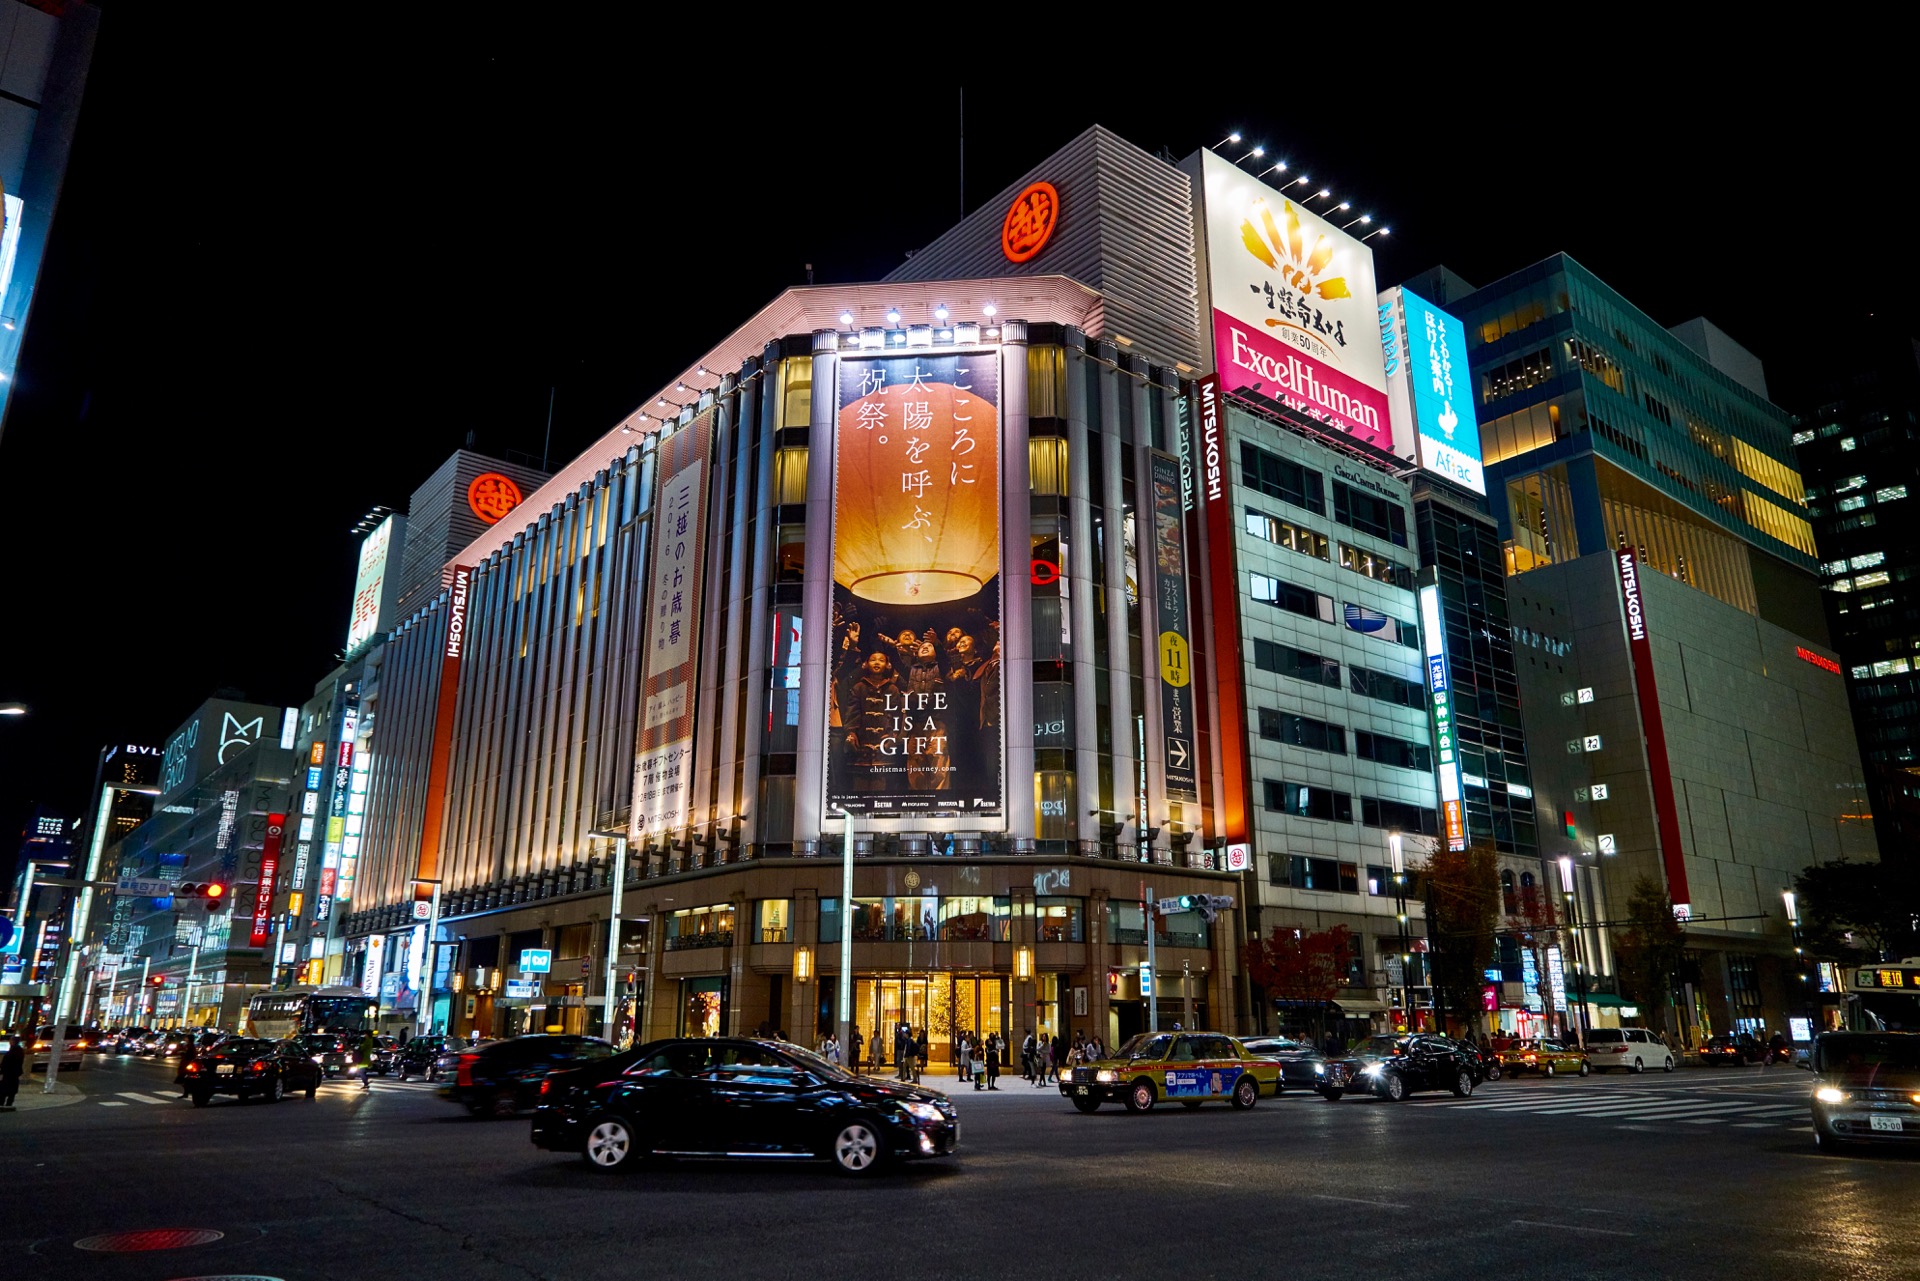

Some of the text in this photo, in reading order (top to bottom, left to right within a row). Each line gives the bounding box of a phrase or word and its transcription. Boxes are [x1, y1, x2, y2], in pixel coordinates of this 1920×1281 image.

[1377, 301, 1399, 378] アフラック
[1424, 310, 1445, 396] ほけん案内
[856, 368, 889, 445] 祝祭。
[1230, 326, 1380, 432] ExcelHuman
[951, 368, 976, 485] こころに
[1202, 382, 1221, 501] MITSUKOSHI
[1154, 465, 1174, 476] GINZA
[1154, 472, 1175, 484] DINING
[1436, 449, 1471, 483] Aflac
[665, 497, 674, 556] 2016
[668, 485, 690, 645] 三越のお歳暮
[1621, 554, 1645, 641] MITSUKOSHI
[447, 571, 468, 658] MITSUKOSHI
[884, 692, 948, 711] LIFE
[893, 716, 937, 731] IS A
[870, 764, 957, 774] christmas-journey.com
[879, 736, 947, 756] GIFT
[254, 860, 275, 935] 三菱東京UFJ銀行
